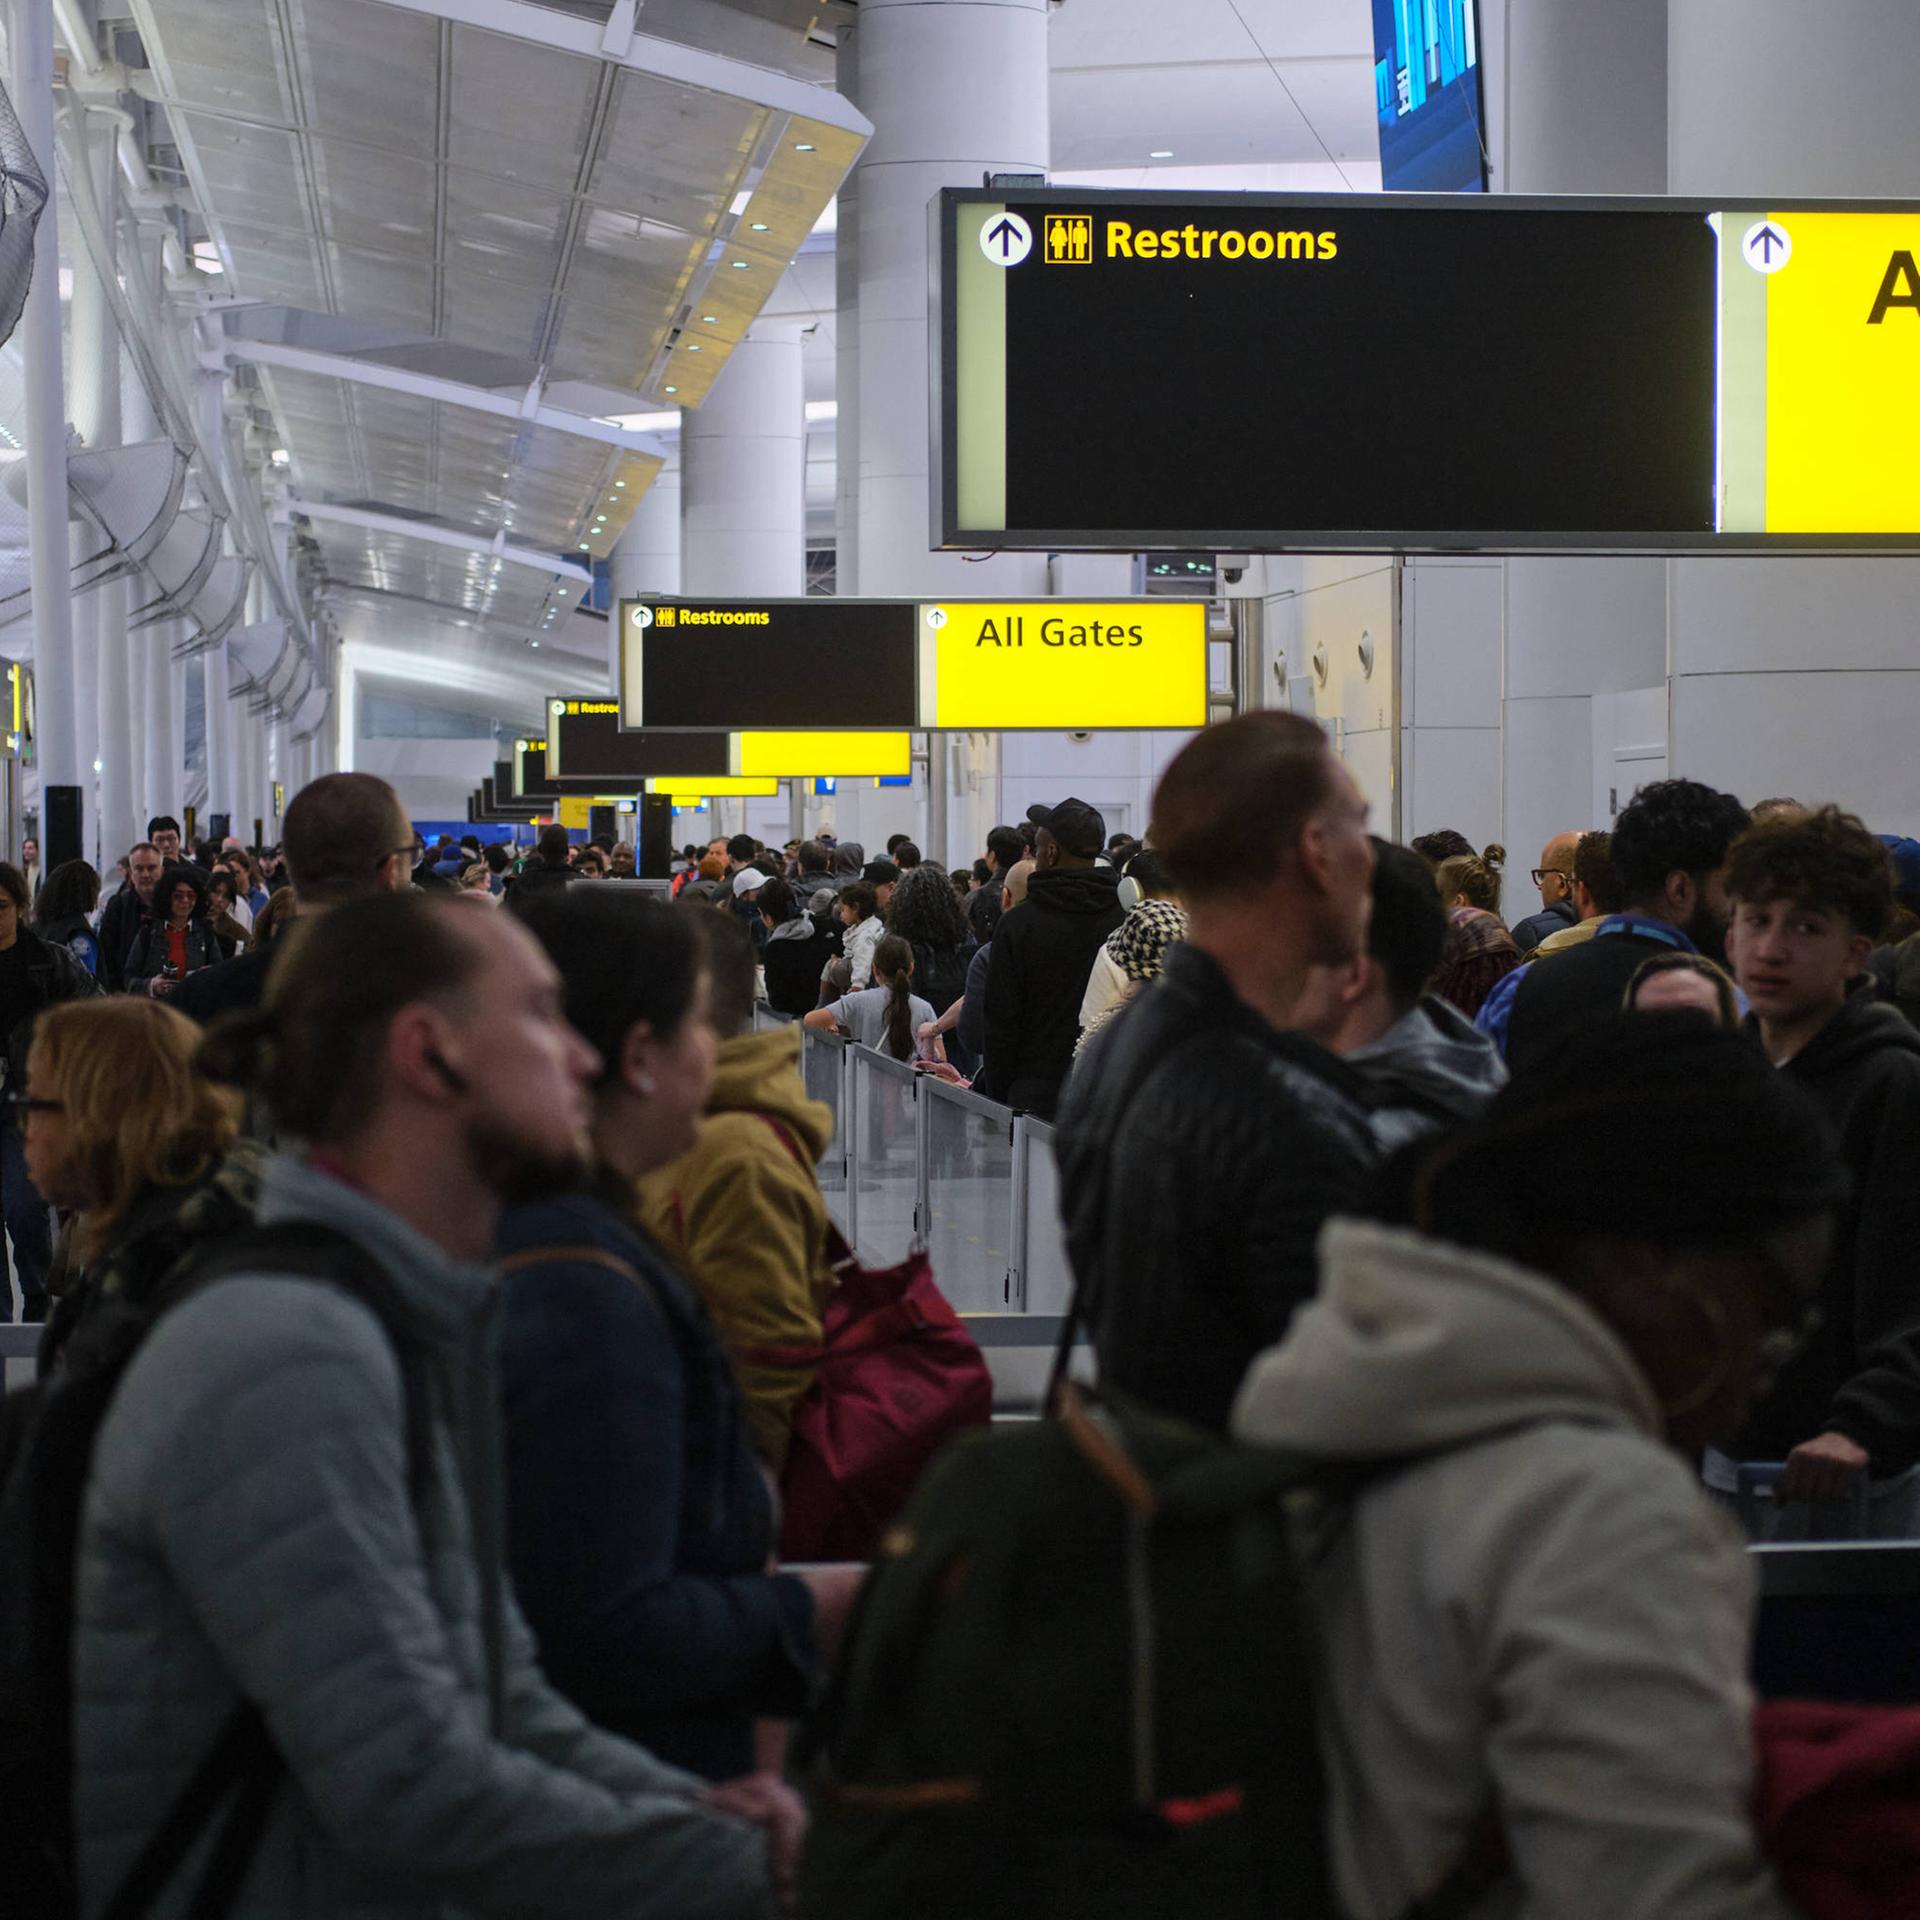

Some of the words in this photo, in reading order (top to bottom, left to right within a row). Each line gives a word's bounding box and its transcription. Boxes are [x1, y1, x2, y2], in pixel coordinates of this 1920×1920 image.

[1106, 220, 1338, 260] Restrooms
[679, 609, 770, 625] Restrooms
[976, 616, 1023, 647] All
[1040, 617, 1143, 647] Gates
